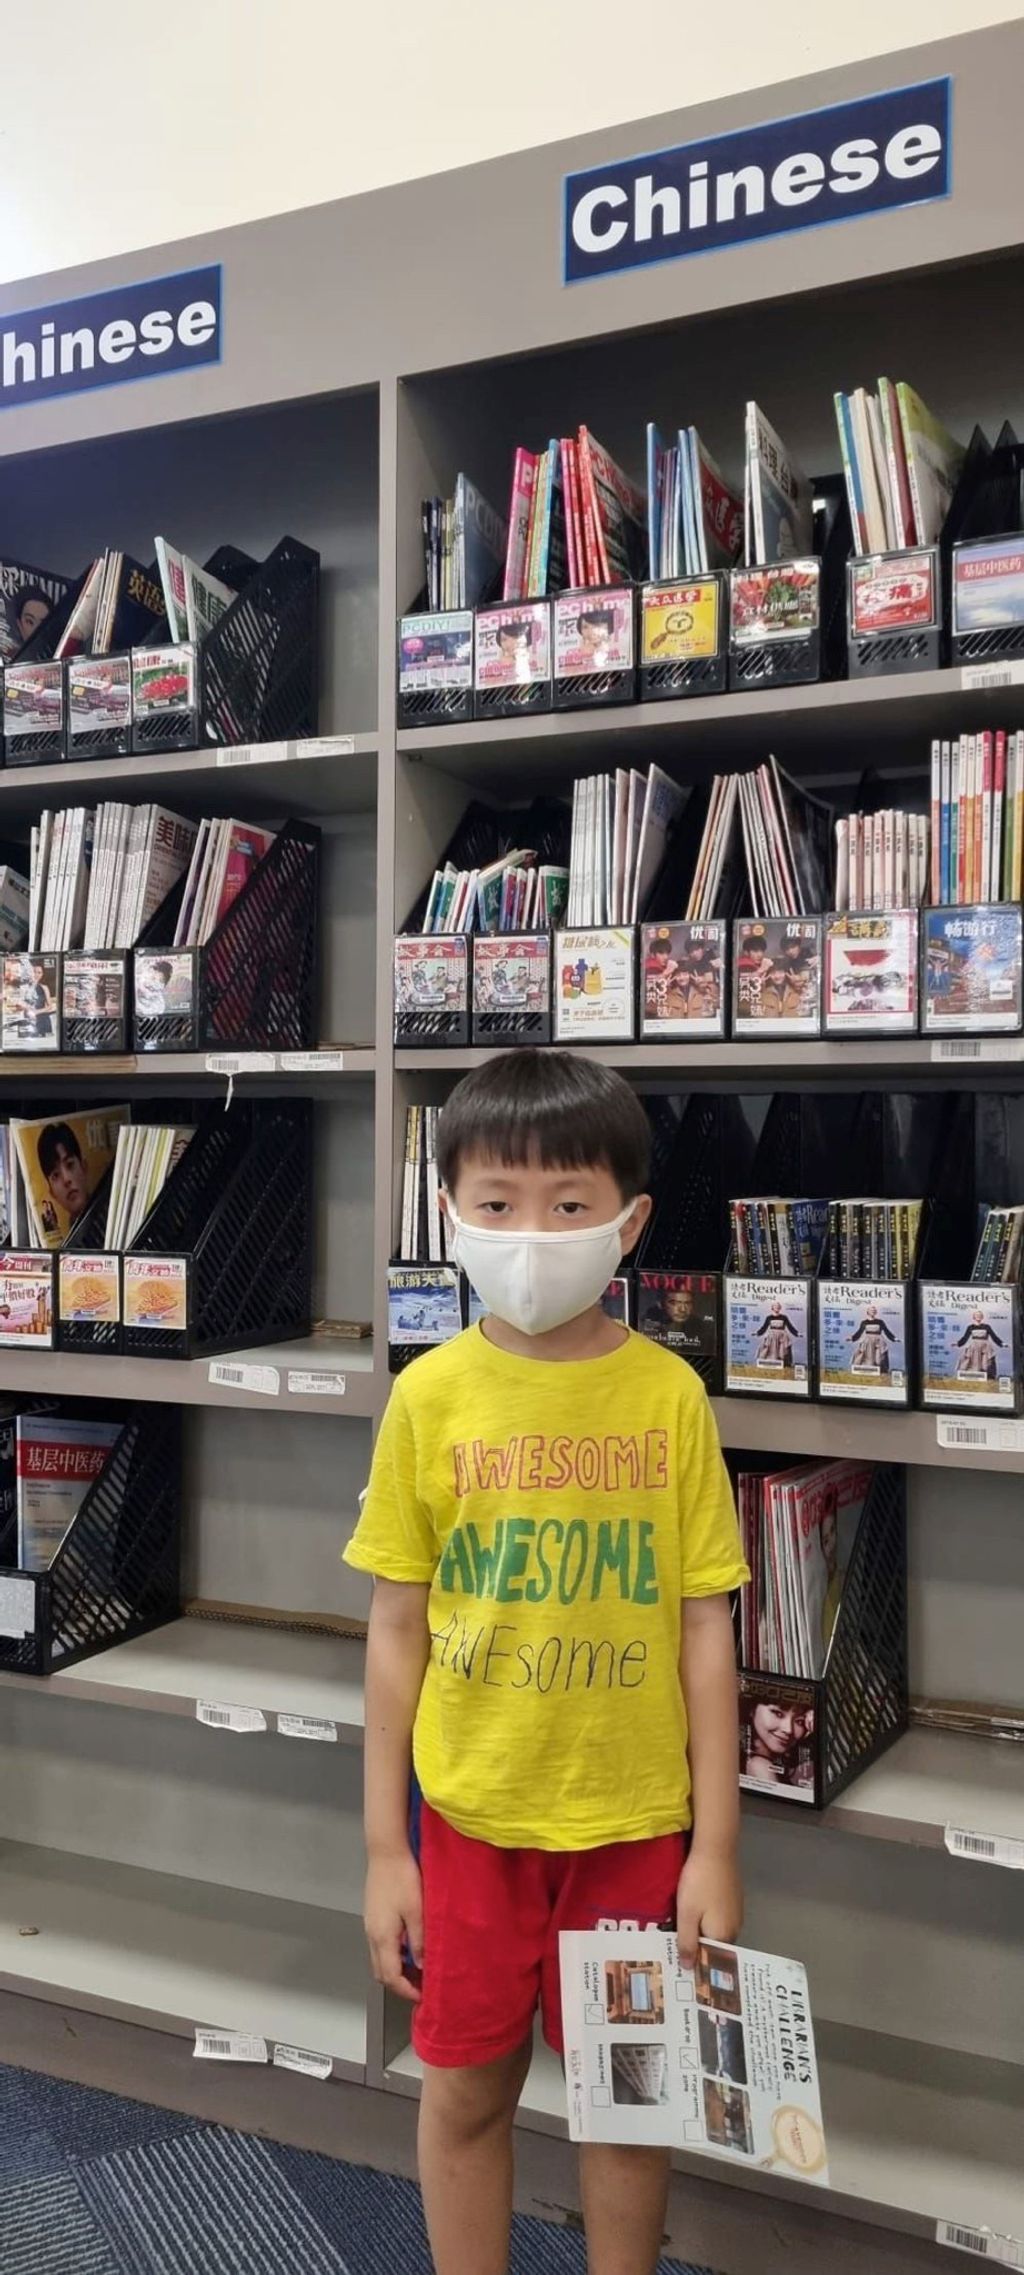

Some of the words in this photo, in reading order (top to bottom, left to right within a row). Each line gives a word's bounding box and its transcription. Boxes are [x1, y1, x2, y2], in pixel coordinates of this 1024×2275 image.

[571, 122, 942, 254] Chinese
[746, 1282, 806, 1297] Reader's
[841, 1286, 903, 1299] Reader's
[752, 1294, 777, 1302] Digest
[846, 1297, 872, 1305] Digest
[945, 1290, 1011, 1304] Reader's
[951, 1302, 978, 1310] Digest
[26, 1446, 106, 1474] 基层中医药
[440, 1518, 659, 1605] AWESOME
[776, 1985, 796, 2082] CHALLENGE
